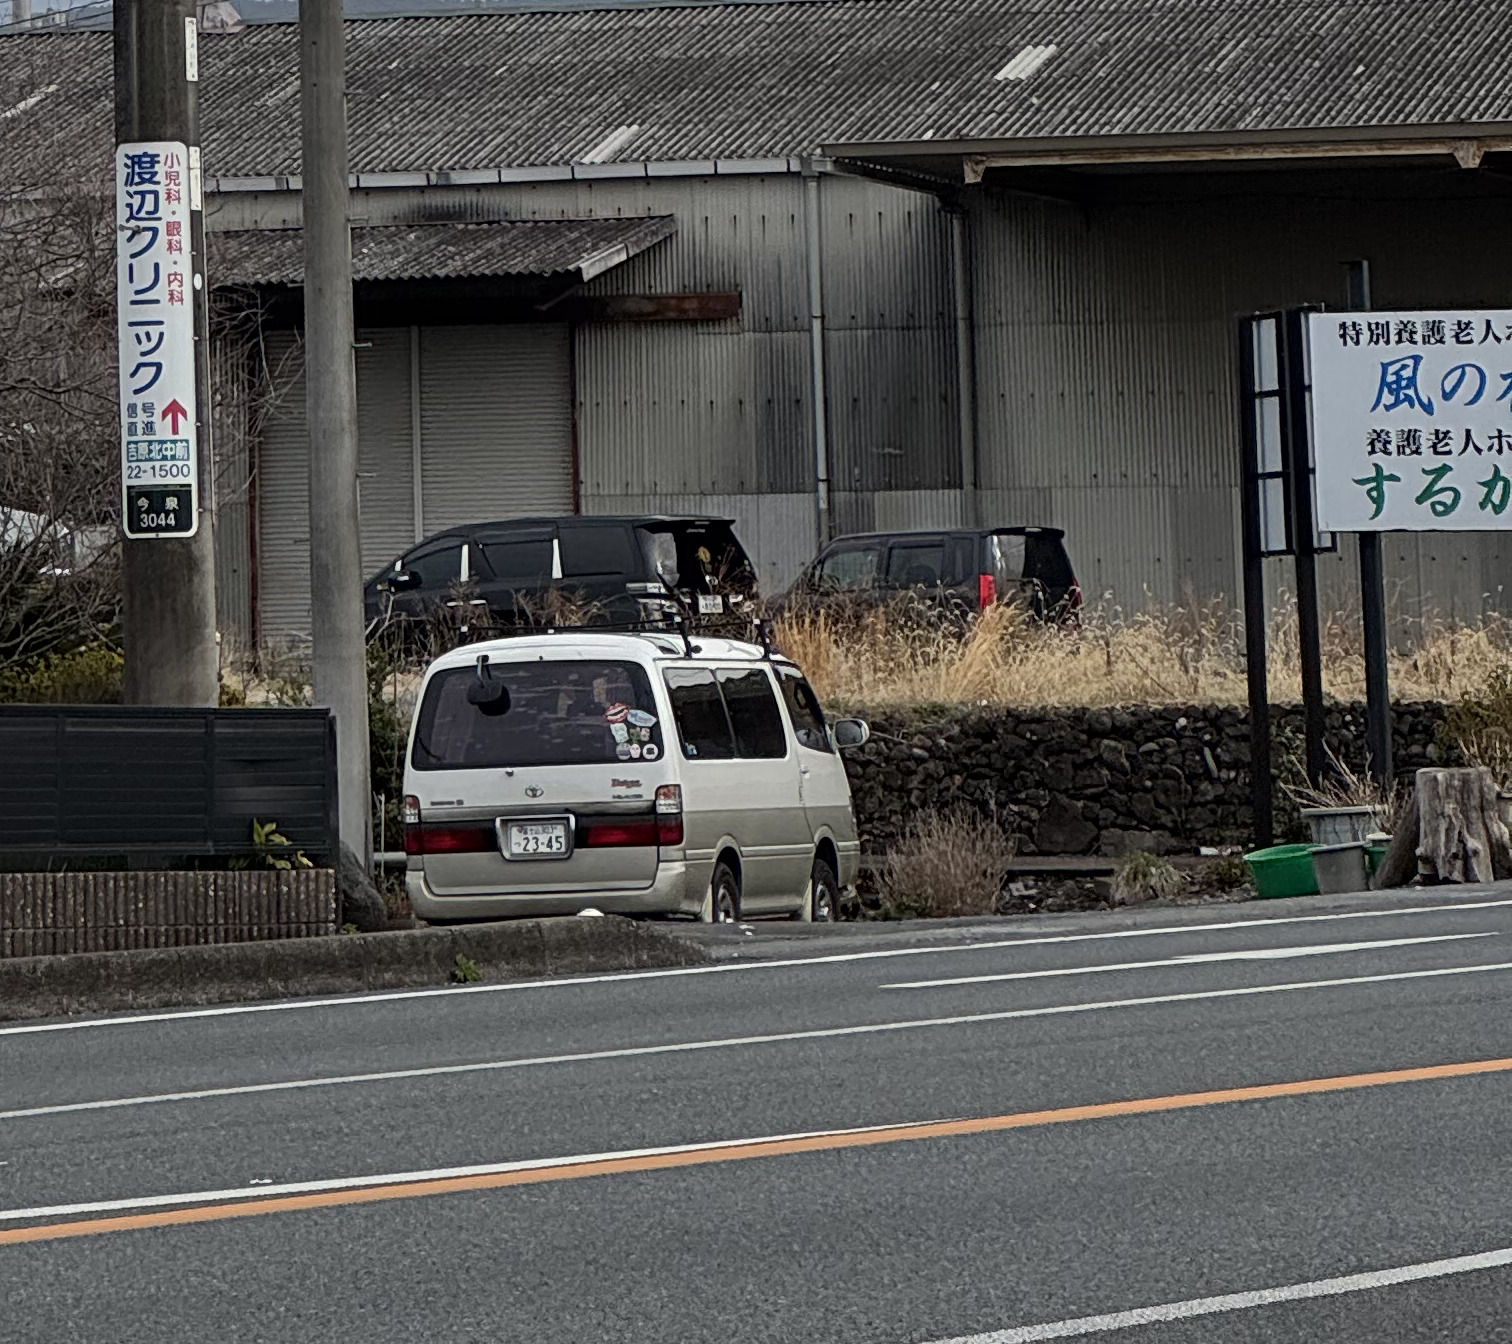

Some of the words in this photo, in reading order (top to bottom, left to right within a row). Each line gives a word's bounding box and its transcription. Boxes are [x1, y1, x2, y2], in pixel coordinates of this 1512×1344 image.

[124, 152, 165, 395] 渡辺クリニック
[1339, 320, 1512, 347] 特別養護老人
[127, 402, 155, 418] 信号
[127, 421, 156, 436] 直進
[128, 442, 188, 460] 吉原北中前
[1367, 428, 1512, 457] 養護老人ホ
[127, 464, 190, 479] 22-1500
[140, 513, 175, 528] 3044
